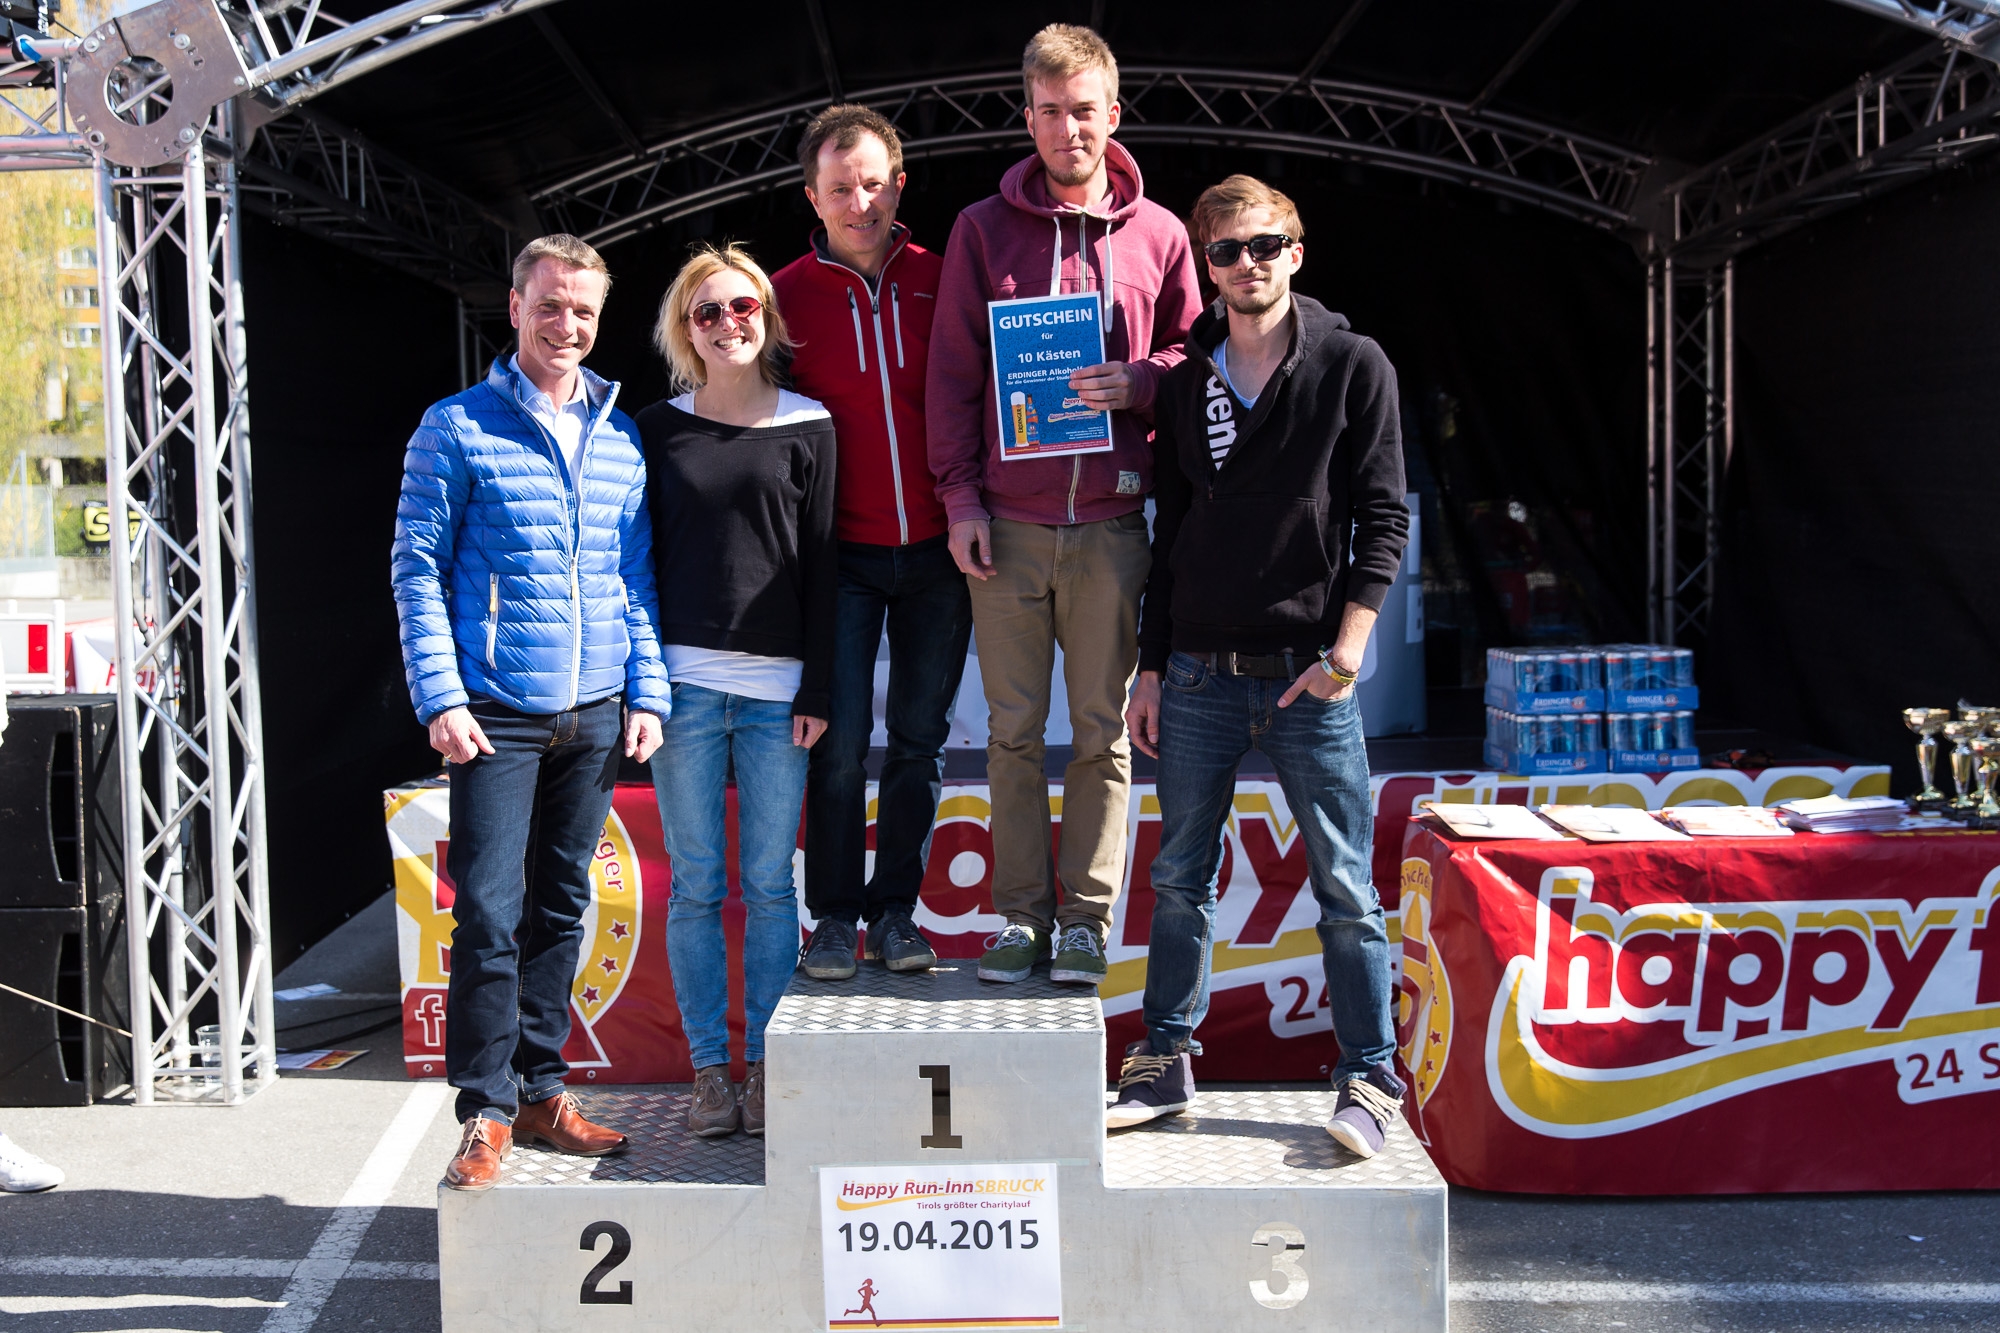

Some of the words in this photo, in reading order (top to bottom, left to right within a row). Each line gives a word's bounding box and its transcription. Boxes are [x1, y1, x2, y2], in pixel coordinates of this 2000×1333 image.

[999, 308, 1093, 330] GUTSCHEIN
[1041, 332, 1054, 340] für
[1018, 353, 1033, 363] 10
[1036, 349, 1081, 362] Kästen
[1007, 369, 1047, 380] ERDINGER
[1536, 758, 1572, 768] ERDINGER
[1541, 878, 1957, 1034] happy
[1906, 1047, 1964, 1091] 24
[919, 1065, 962, 1149] 1
[842, 1181, 899, 1199] Happy
[903, 1178, 1045, 1195] Run-InnSBRUCK
[917, 1202, 942, 1210] Tirols
[943, 1201, 978, 1211] größter
[980, 1200, 1031, 1210] Charitylauf
[838, 1220, 1039, 1252] 19.04.2015
[580, 1220, 633, 1305] 2
[1248, 1221, 1310, 1310] 3
